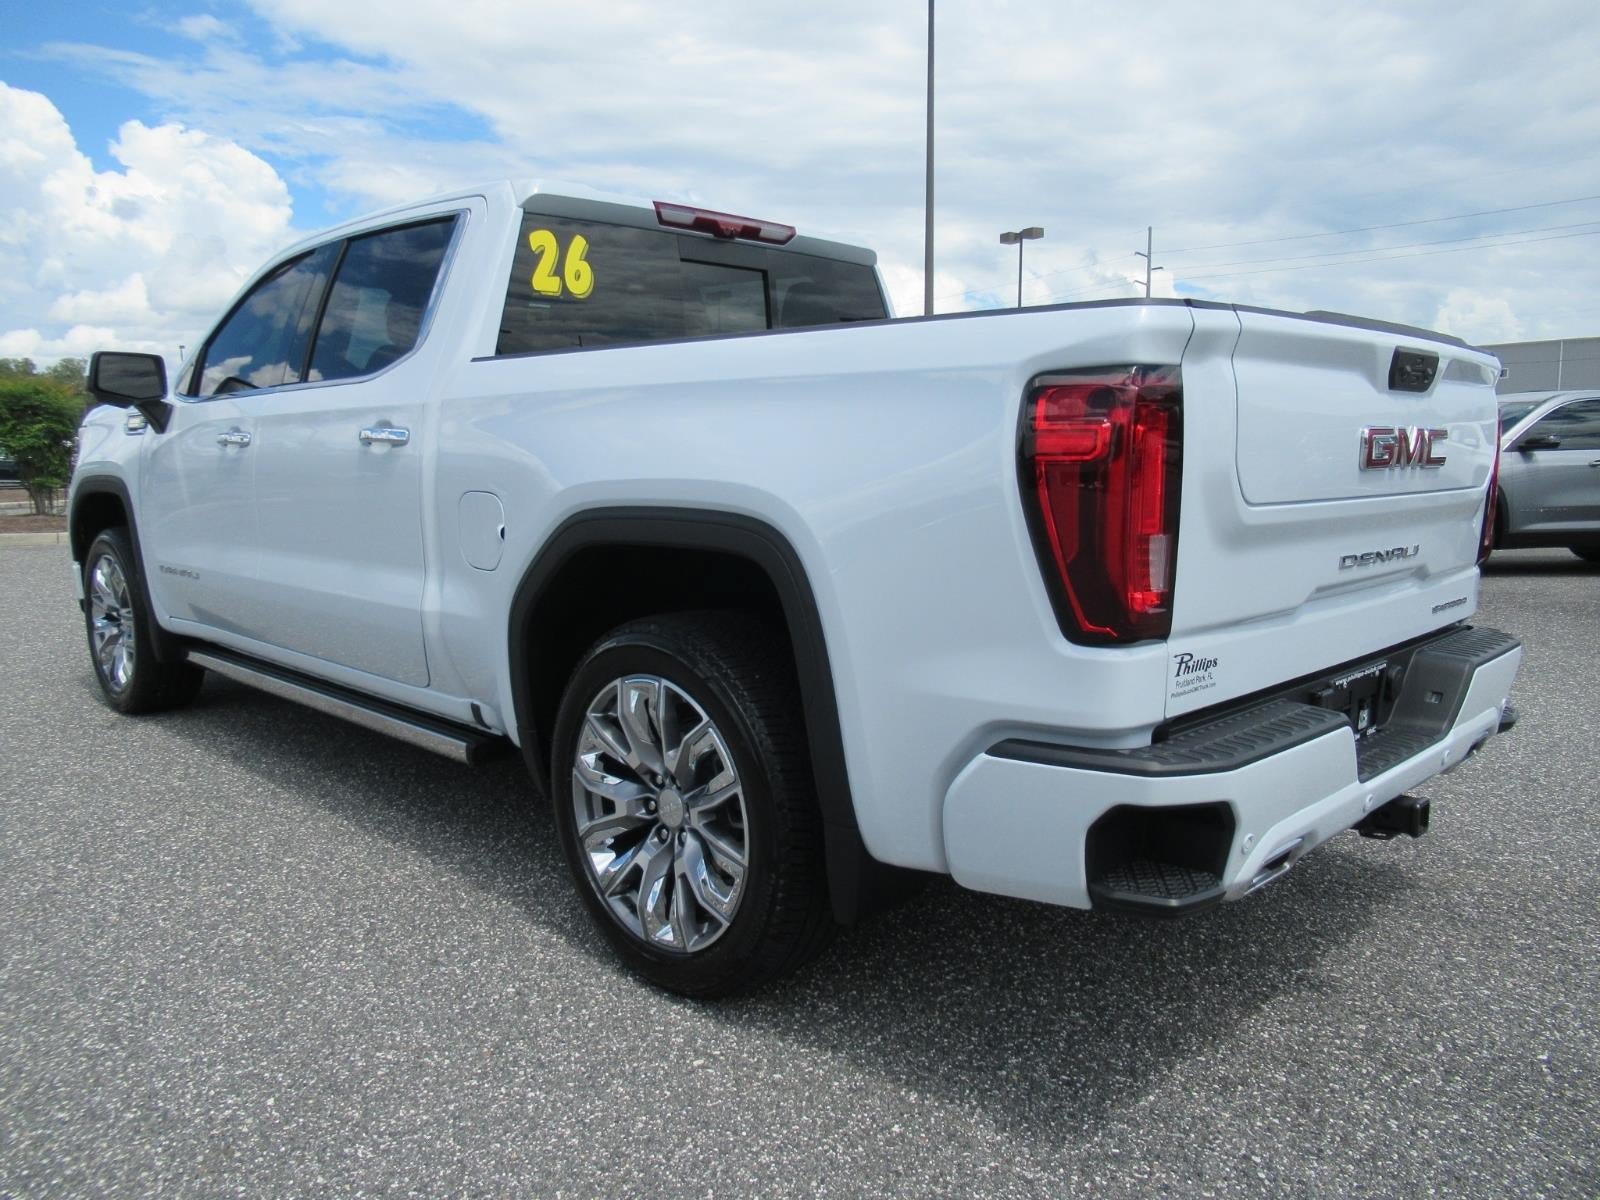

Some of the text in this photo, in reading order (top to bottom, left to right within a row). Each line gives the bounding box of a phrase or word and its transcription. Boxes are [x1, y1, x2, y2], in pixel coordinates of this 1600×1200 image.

[529, 229, 595, 299] 26
[1359, 425, 1448, 471] GMC
[1338, 544, 1420, 570] DENALI
[1174, 652, 1218, 678] Phillips
